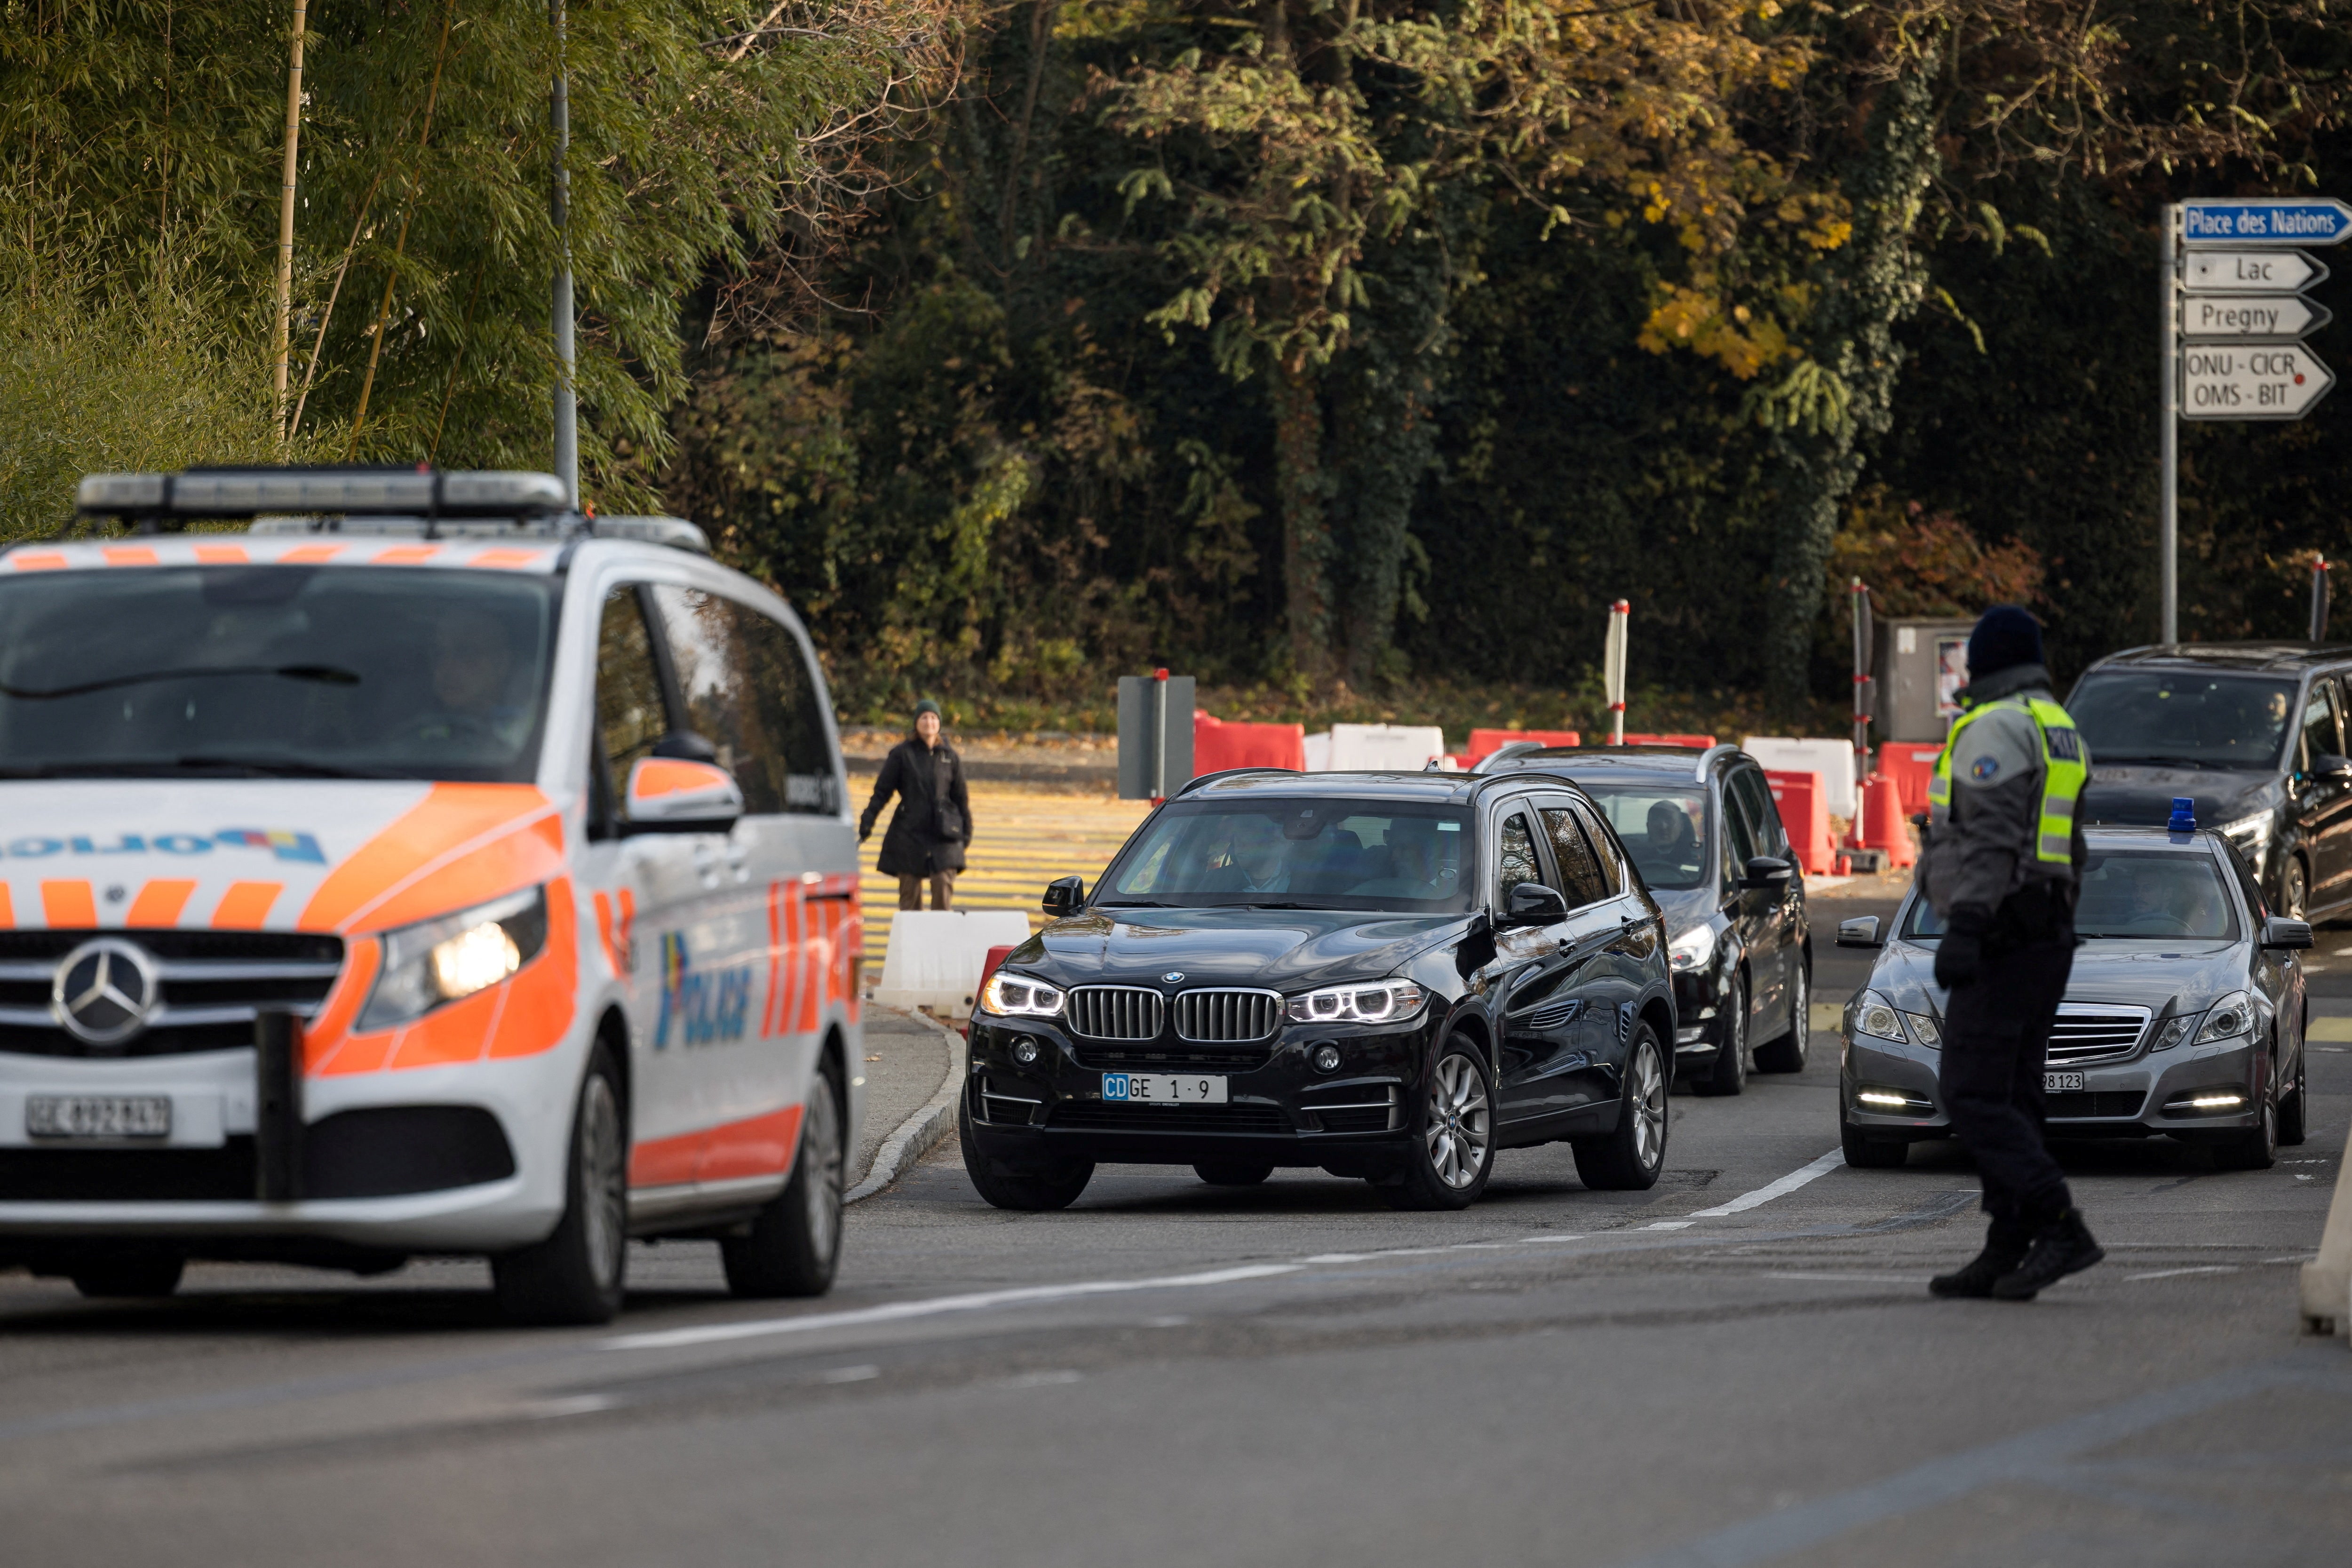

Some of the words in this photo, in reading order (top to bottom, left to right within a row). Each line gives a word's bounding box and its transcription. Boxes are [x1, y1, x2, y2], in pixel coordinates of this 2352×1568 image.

[2189, 208, 2233, 234] Place
[2237, 208, 2267, 234] des
[2272, 209, 2336, 234] Nations
[2237, 257, 2273, 281] Lac
[2202, 303, 2279, 334] Pregny
[2188, 353, 2233, 376] ONU
[2250, 353, 2296, 376] CICR
[2194, 384, 2241, 406] OMS
[2259, 383, 2288, 406] BIT
[1105, 1077, 1127, 1097] CD
[1130, 1078, 1151, 1098] GE
[2058, 1075, 2081, 1088] 123
